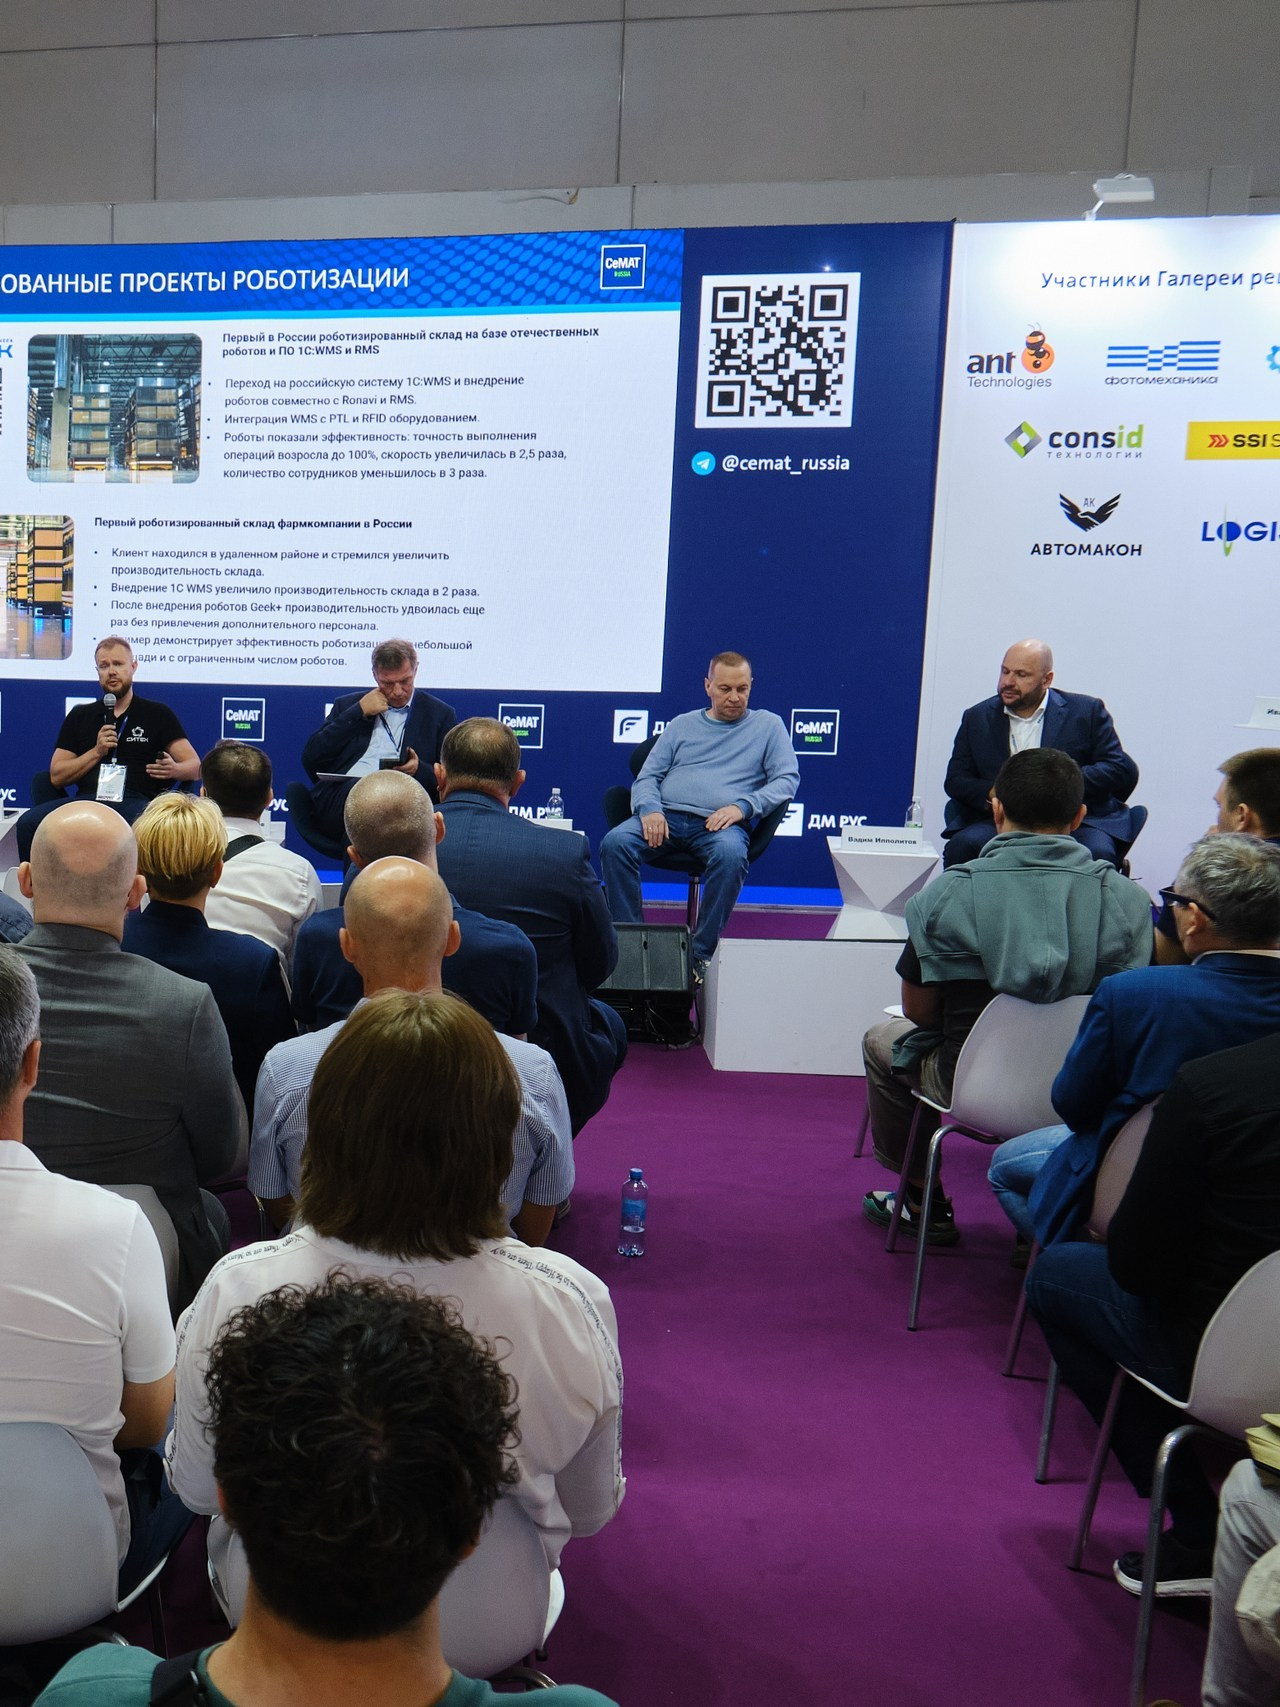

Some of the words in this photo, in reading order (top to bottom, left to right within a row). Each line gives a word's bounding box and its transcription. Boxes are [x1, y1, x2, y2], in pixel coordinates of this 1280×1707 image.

[605, 257, 641, 269] CeMAT
[120, 272, 226, 293] ПРОЕКТЫ
[233, 267, 410, 292] РОБОТИЗАЦИИ
[1041, 271, 1150, 289] Участники
[1158, 270, 1243, 291] Галереи
[223, 332, 265, 344] Первый
[278, 333, 316, 342] России
[319, 330, 426, 344] роботизированный
[429, 332, 462, 341] склад
[466, 331, 478, 339] на
[482, 328, 507, 338] базе
[510, 328, 599, 338] отечественных
[223, 343, 266, 358] роботов
[279, 346, 294, 355] ПО
[355, 345, 379, 354] RMS
[967, 351, 1016, 374] ant
[226, 379, 271, 390] Переход
[290, 378, 355, 390] российскую
[358, 379, 403, 389] систему
[464, 377, 524, 387] внедрение
[967, 376, 1052, 389] Technologies
[1105, 374, 1218, 385] фотомеханика
[225, 396, 268, 408] роботов
[343, 395, 377, 404] Ronavi
[390, 395, 416, 404] RMS.
[225, 415, 287, 425] Интеграция
[291, 414, 317, 423] WMS
[330, 414, 348, 423] PTL
[362, 413, 386, 423] RFID
[390, 414, 479, 425] оборудованием.
[225, 432, 264, 442] Роботы
[322, 432, 409, 443] эффективность:
[1048, 424, 1143, 448] consid
[1233, 433, 1267, 448] SSI
[224, 450, 274, 462] операций
[278, 452, 328, 462] возросла
[331, 452, 345, 461] до
[349, 450, 378, 461] 100%,
[381, 452, 432, 462] скорость
[435, 451, 506, 461] увеличилась
[519, 449, 535, 460] 2,5
[538, 450, 566, 461] раза,
[1047, 450, 1143, 459] технологии
[722, 454, 850, 475] @cemat_russia
[224, 470, 285, 478] количество
[288, 470, 357, 480] сотрудников
[361, 470, 436, 480] уменьшилось
[449, 468, 455, 477] 3
[459, 470, 486, 480] раза.
[95, 517, 136, 528] Первый
[139, 518, 240, 529] роботизированный
[243, 521, 275, 529] склад
[278, 519, 360, 530] фармкомпании
[373, 519, 412, 528] России
[1202, 521, 1280, 541] LOGI
[112, 548, 148, 557] Клиент
[152, 551, 207, 559] находился
[220, 552, 278, 560] удаленном
[281, 550, 319, 560] районе
[331, 552, 389, 561] стремился
[393, 553, 449, 562] увеличить
[1030, 543, 1142, 557] АВТОМАКОН
[112, 567, 221, 576] производительность
[225, 568, 264, 577] склада.
[112, 583, 167, 594] Внедрение
[187, 584, 212, 593] WMS
[215, 586, 271, 595] увеличило
[275, 587, 388, 596] производительность
[391, 588, 429, 597] склада
[442, 587, 448, 596] 2
[452, 589, 479, 598] раза.
[111, 600, 143, 609] После
[146, 603, 201, 612] внедрения
[205, 602, 247, 613] роботов
[251, 602, 282, 611] Geek+
[285, 605, 399, 614] производительность
[402, 606, 459, 616] удвоилась
[463, 607, 485, 616] еще
[111, 619, 128, 628] раз
[131, 617, 148, 626] без
[152, 620, 219, 629] привлечения
[319, 623, 378, 632] персонала.
[153, 638, 233, 648] демонстрирует
[236, 638, 319, 648] эффективность
[178, 656, 255, 664] ограниченным
[301, 656, 347, 667] роботов.
[226, 709, 260, 721] CeMAT
[503, 716, 539, 729] CeMAT
[795, 721, 833, 734] CeMAT
[808, 814, 836, 829] ДМ
[840, 815, 867, 828] РУС
